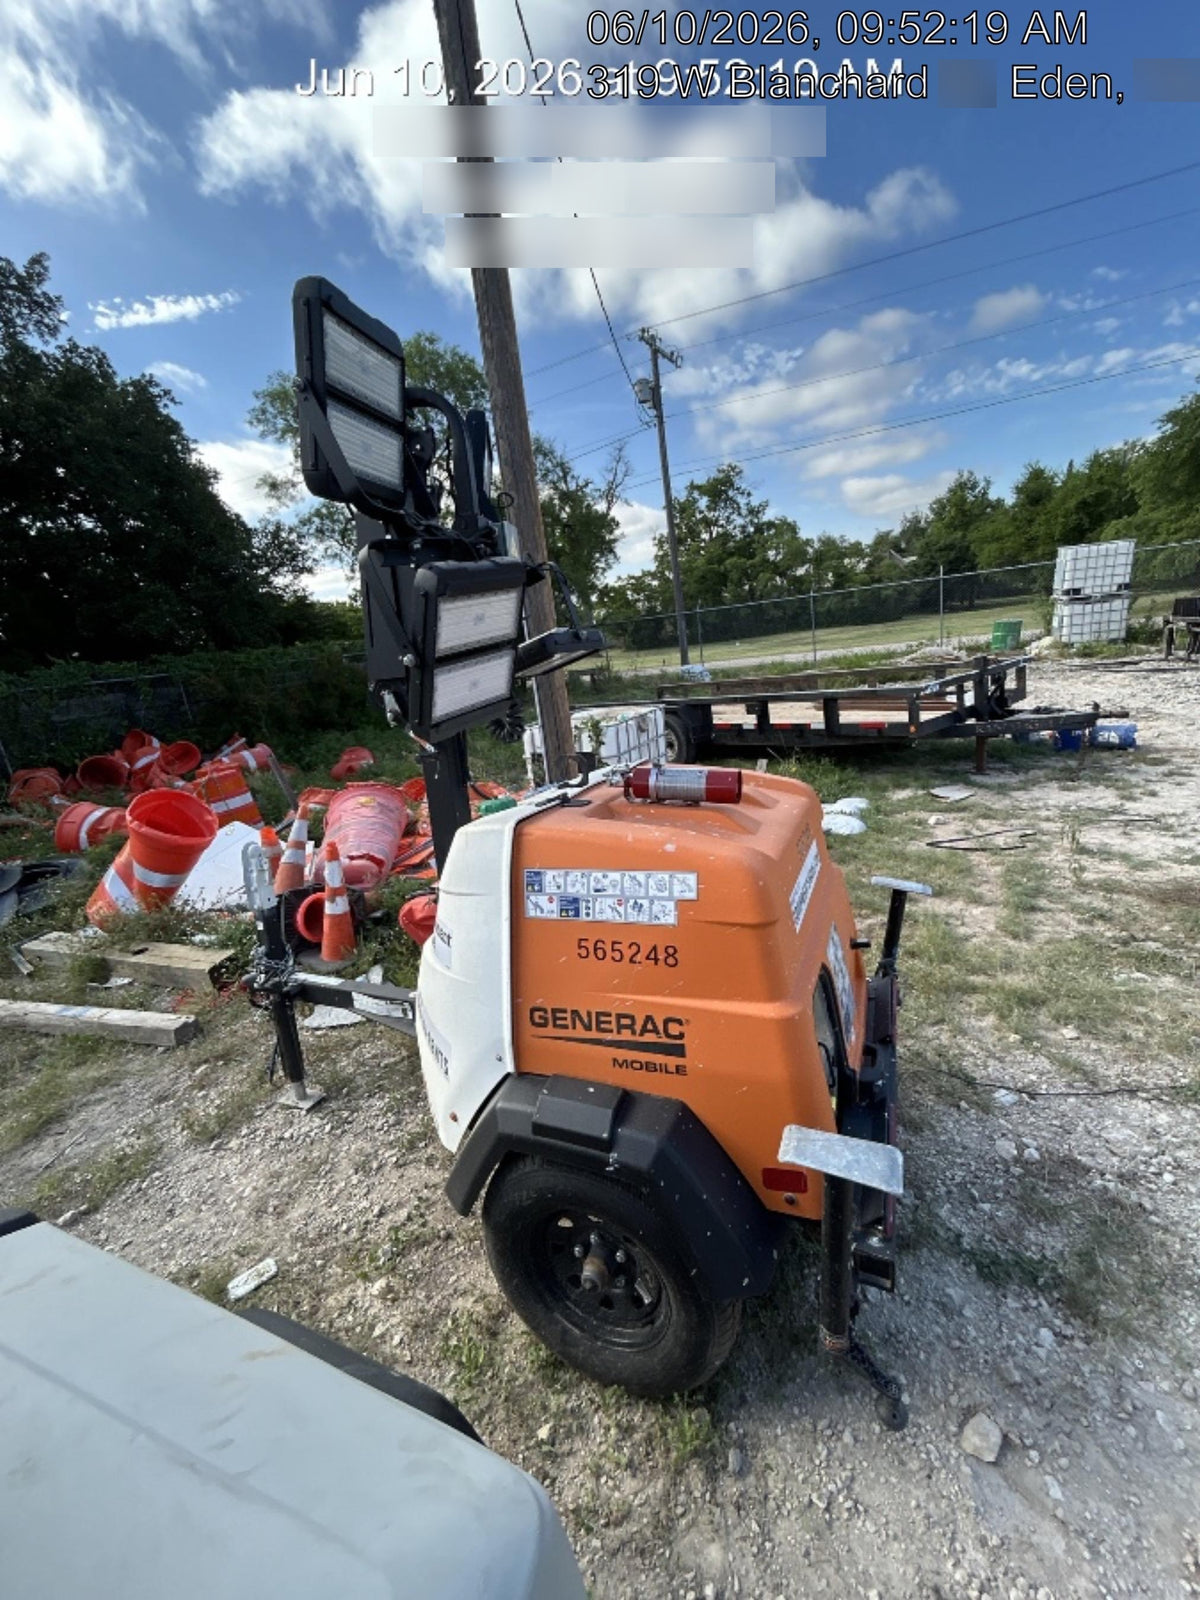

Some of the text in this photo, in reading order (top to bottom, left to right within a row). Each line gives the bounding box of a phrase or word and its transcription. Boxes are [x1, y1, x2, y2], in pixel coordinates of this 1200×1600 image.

[576, 937, 680, 968] 565248
[529, 1005, 686, 1042] GENERAC
[611, 1056, 689, 1077] MOBILE
